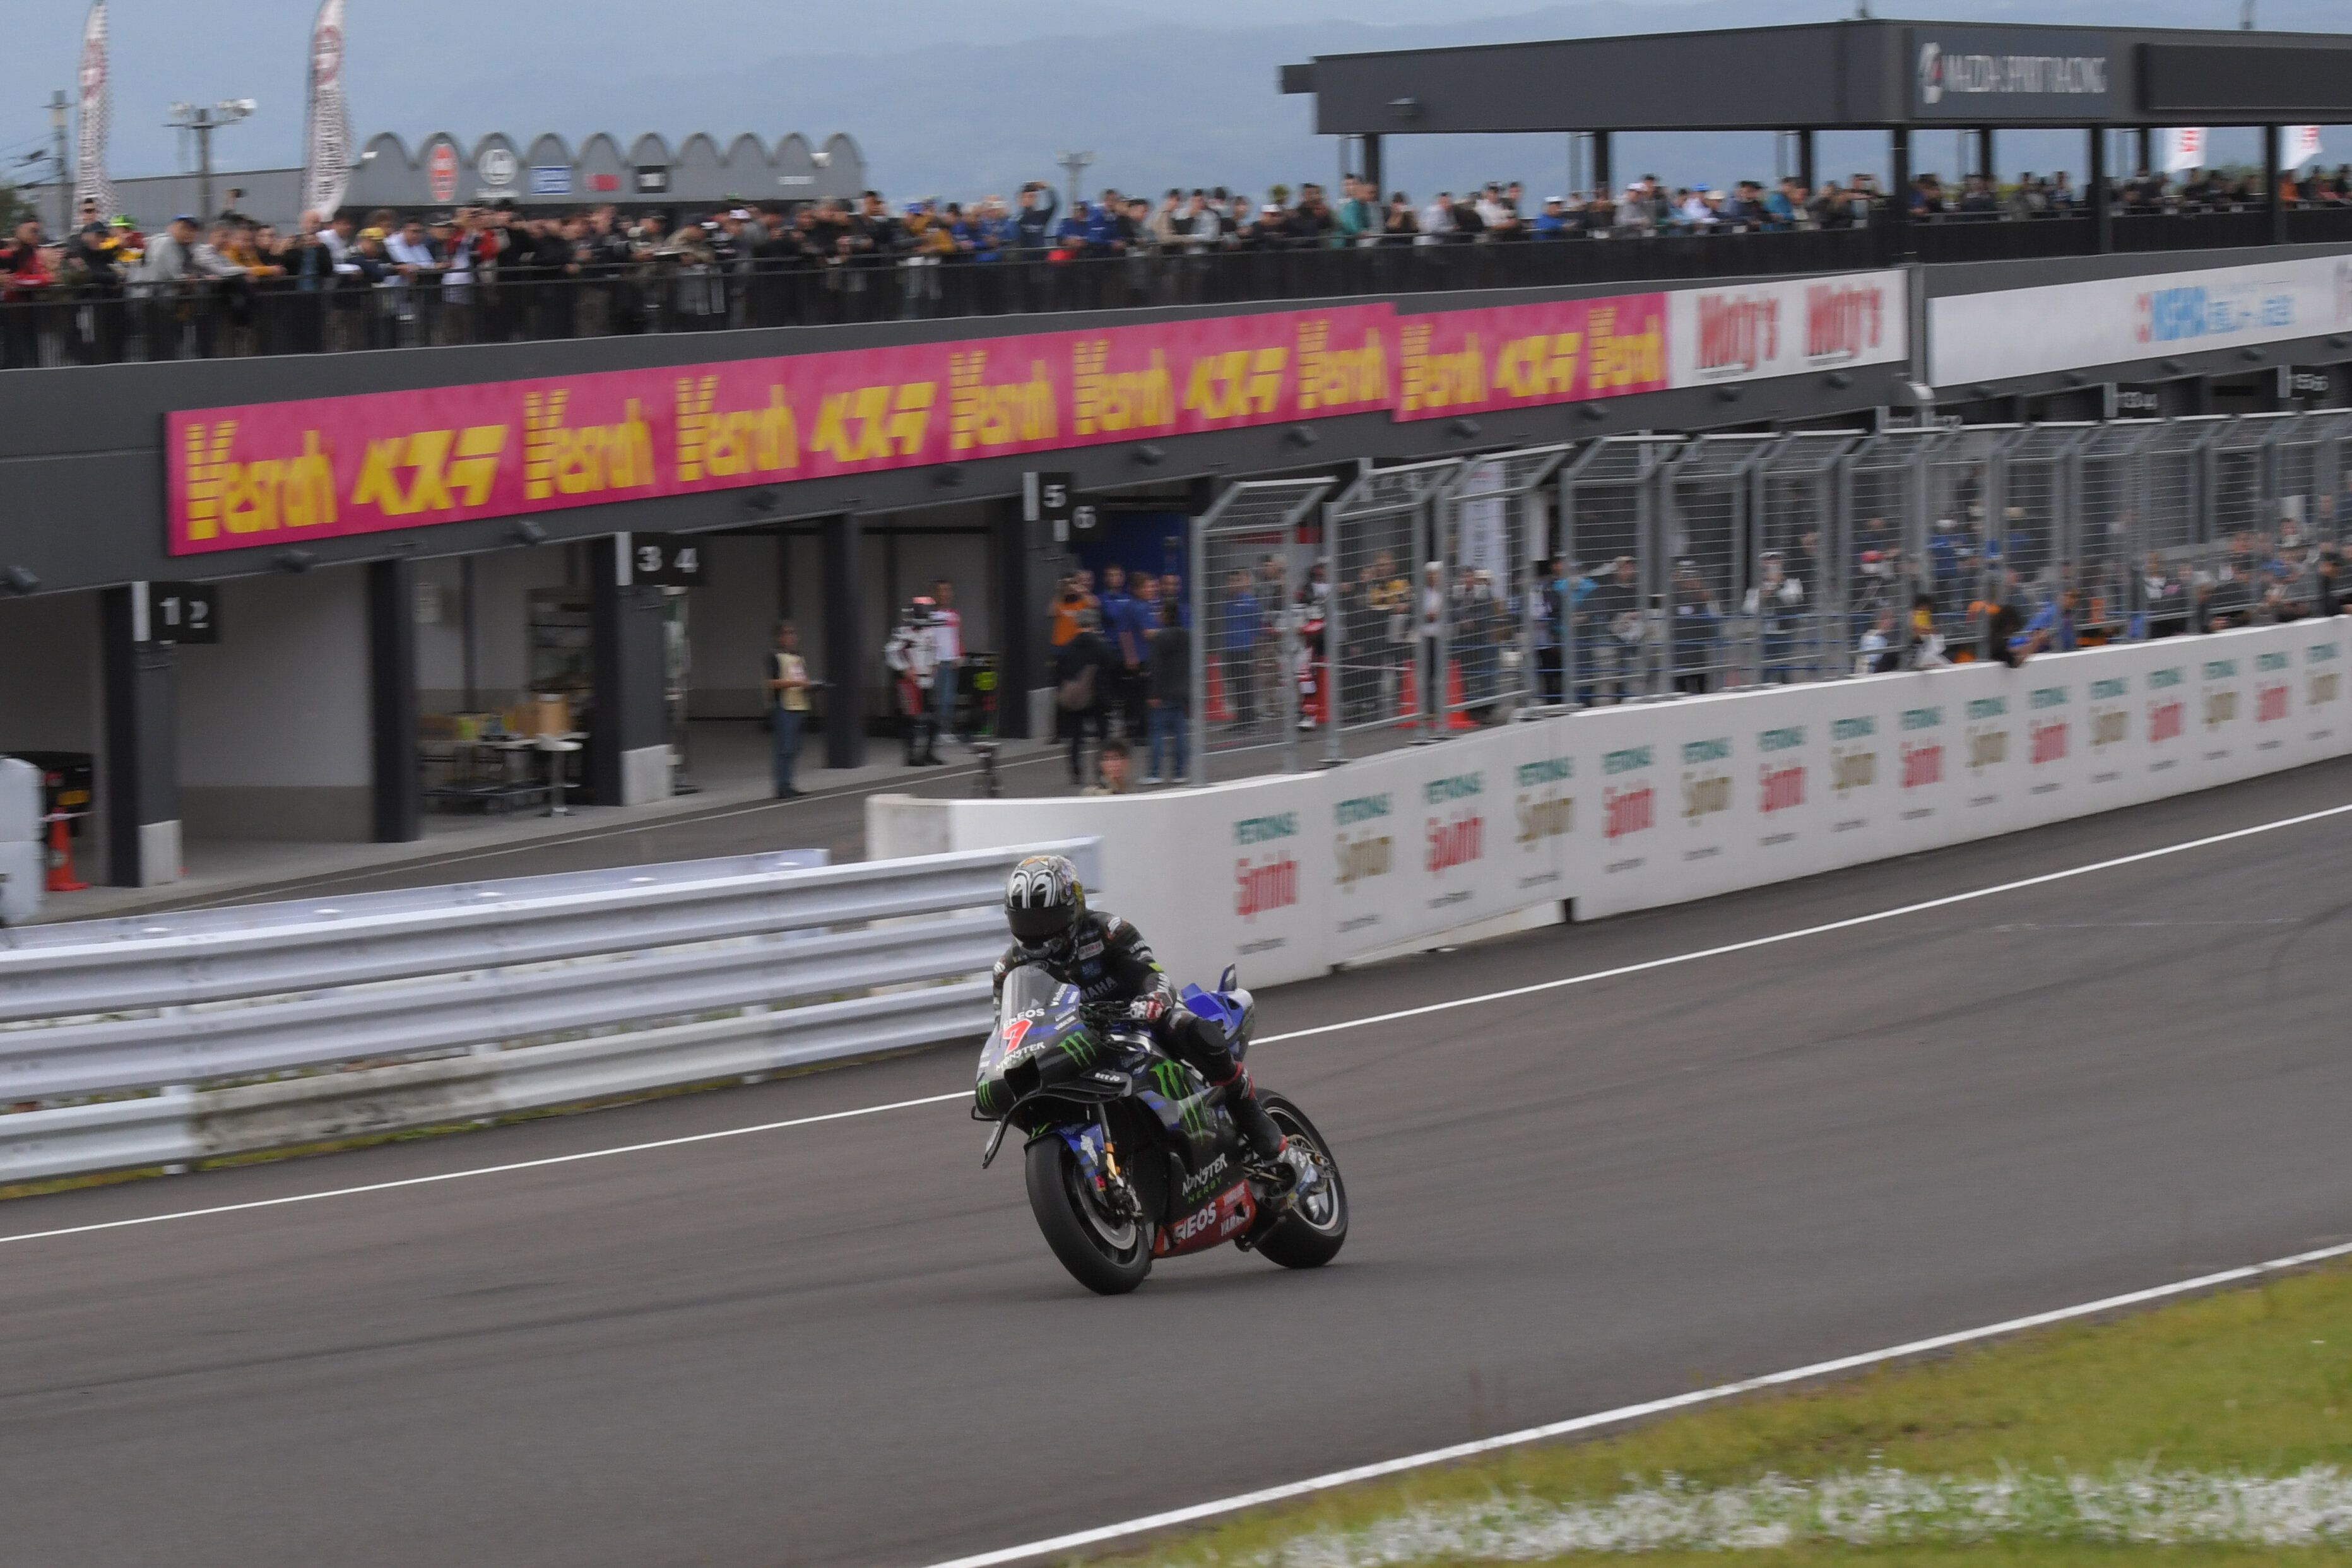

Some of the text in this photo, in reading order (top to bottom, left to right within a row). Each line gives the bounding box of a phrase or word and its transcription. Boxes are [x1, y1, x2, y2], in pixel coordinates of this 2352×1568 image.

[1043, 484, 1067, 508] 5
[1073, 505, 1097, 529] 6
[637, 545, 699, 573] 3 4
[159, 597, 209, 628] 1 2
[1188, 1175, 1222, 1204] NERGY
